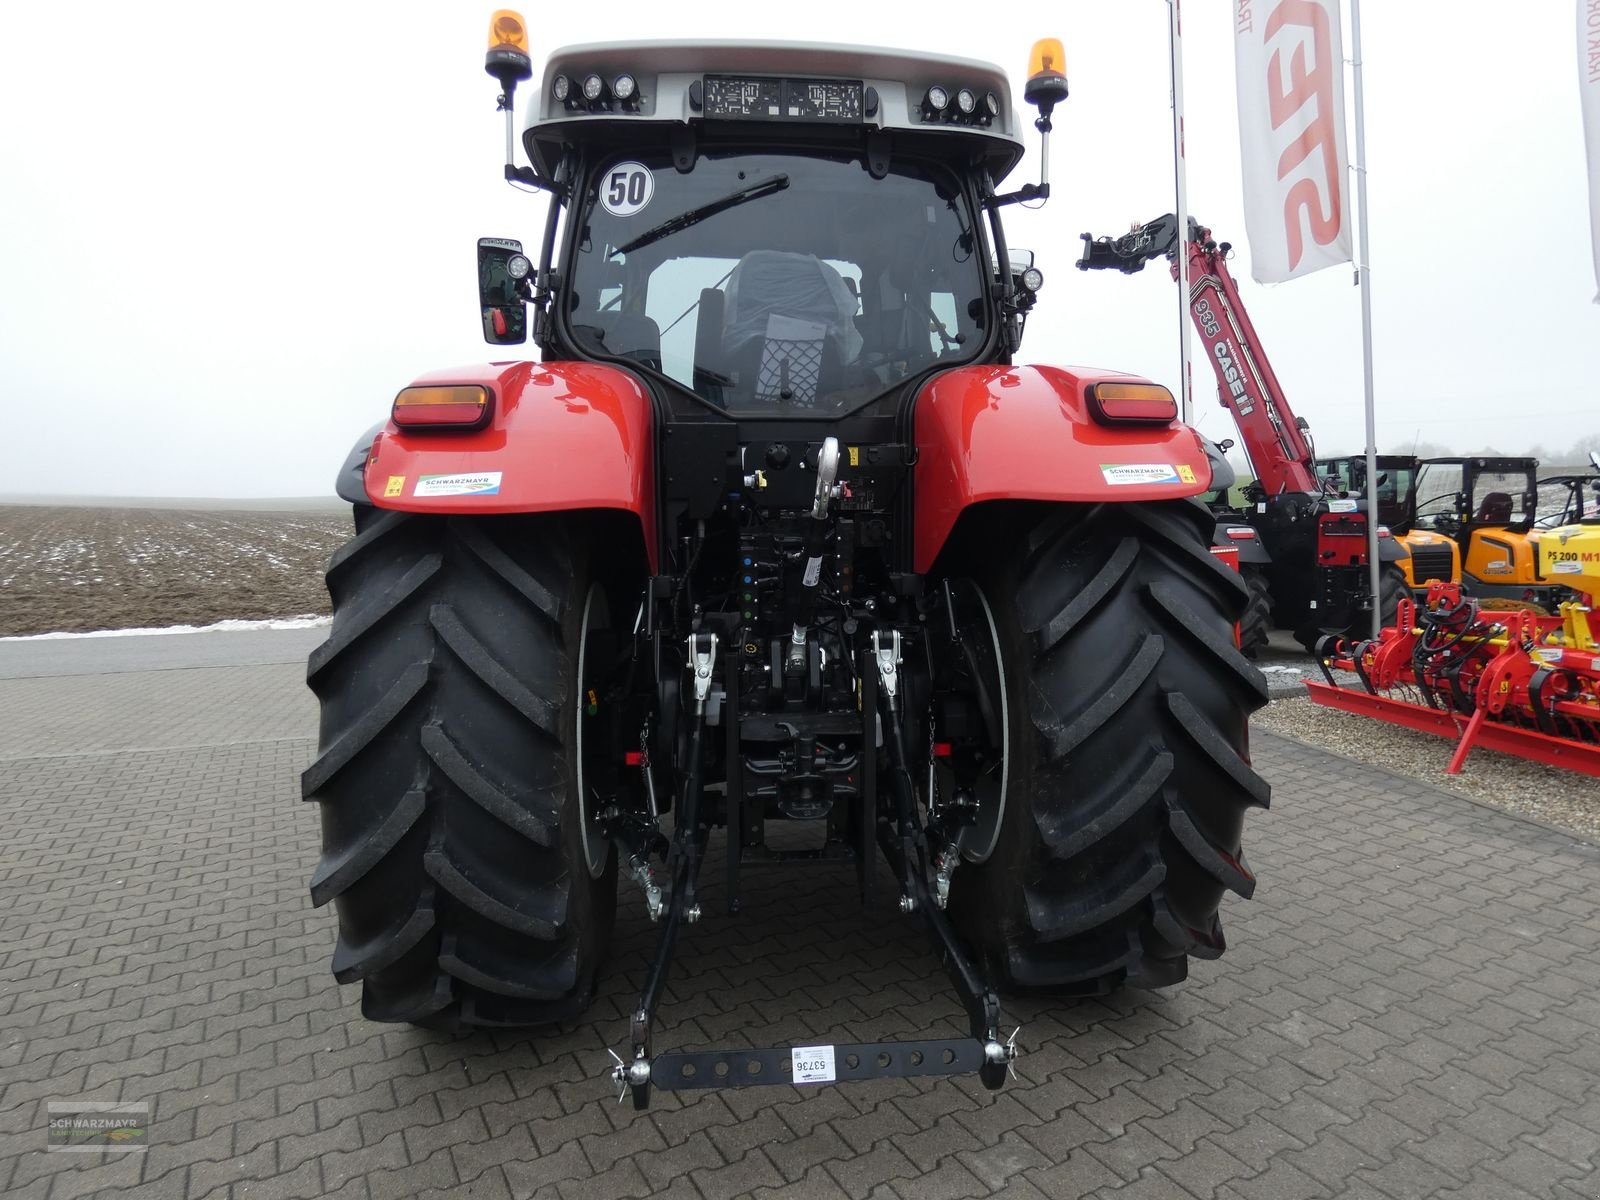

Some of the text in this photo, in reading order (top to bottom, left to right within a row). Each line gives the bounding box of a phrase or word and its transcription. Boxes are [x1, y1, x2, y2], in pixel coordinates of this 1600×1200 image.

[608, 172, 646, 206] 50
[1195, 299, 1220, 337] 935
[1214, 341, 1244, 395] CASE
[425, 478, 489, 486] SCHWARZMAYR
[1548, 551, 1600, 562] PS 200 M1
[797, 1060, 826, 1071] 53736
